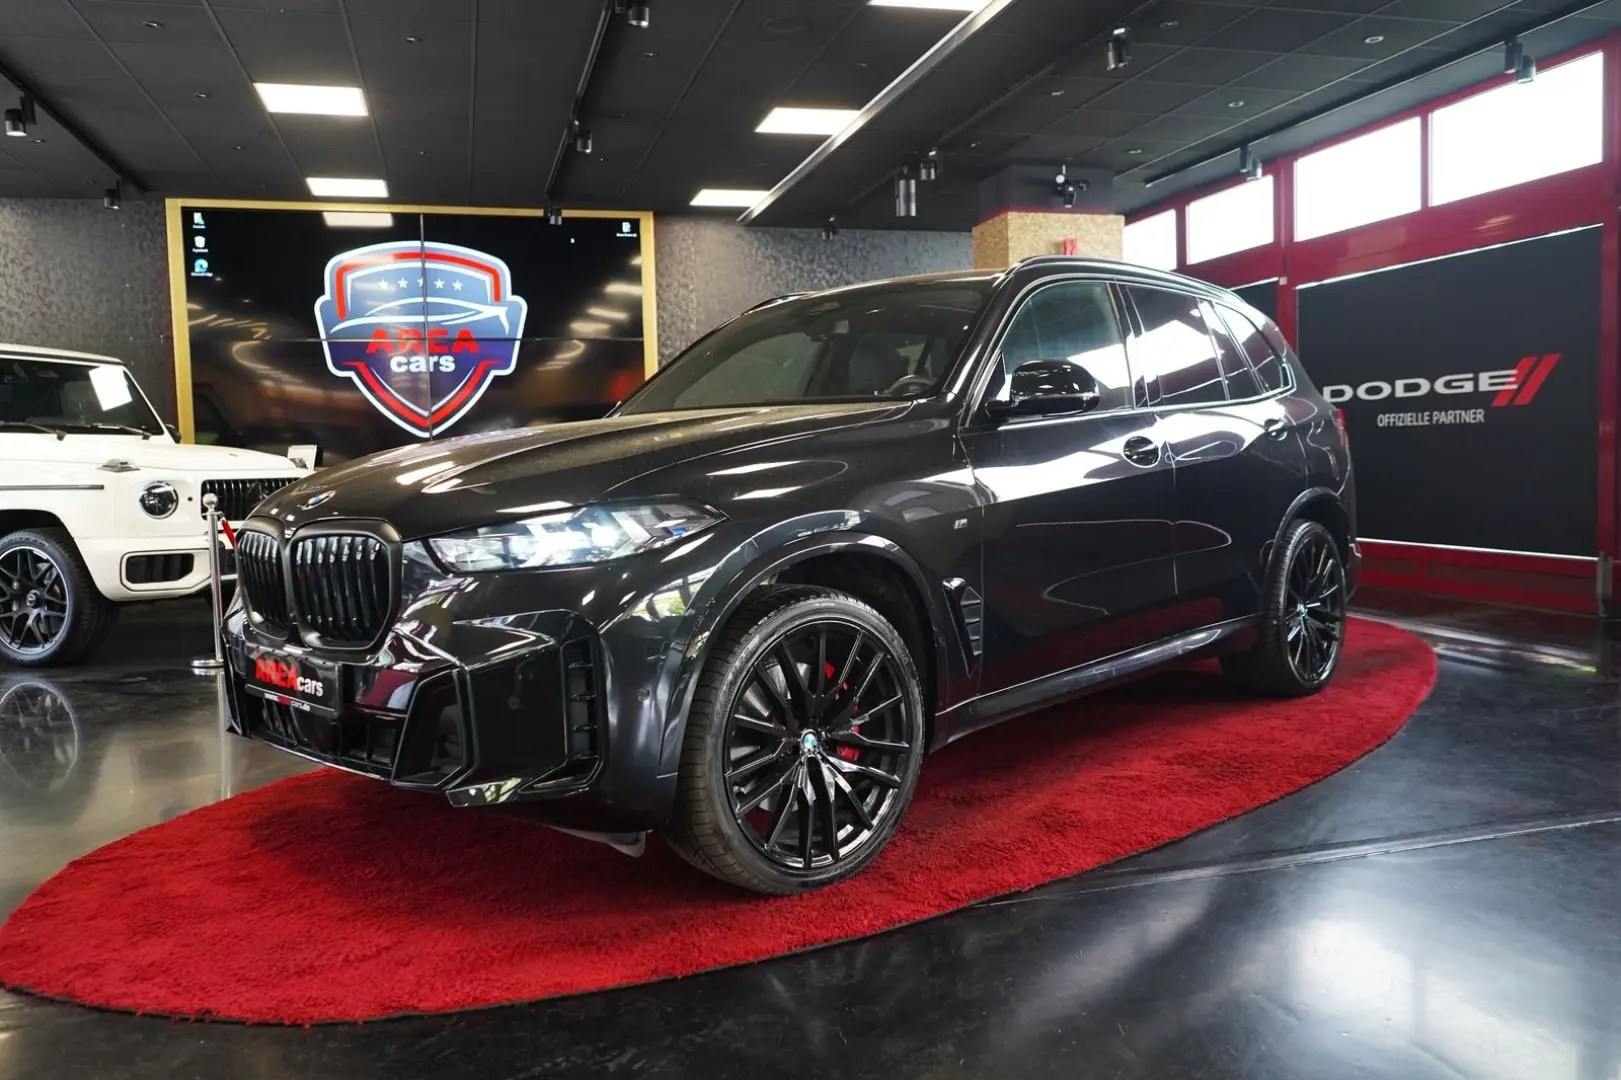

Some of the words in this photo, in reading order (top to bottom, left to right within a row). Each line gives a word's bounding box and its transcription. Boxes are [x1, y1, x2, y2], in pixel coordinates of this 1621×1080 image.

[366, 328, 479, 354] AREA
[389, 355, 456, 373] cars
[1322, 369, 1518, 403] DODGE
[1377, 411, 1430, 427] OFFIZIELLE
[1432, 409, 1485, 425] PARTNER
[255, 656, 299, 692] AREA
[296, 676, 324, 697] cars
